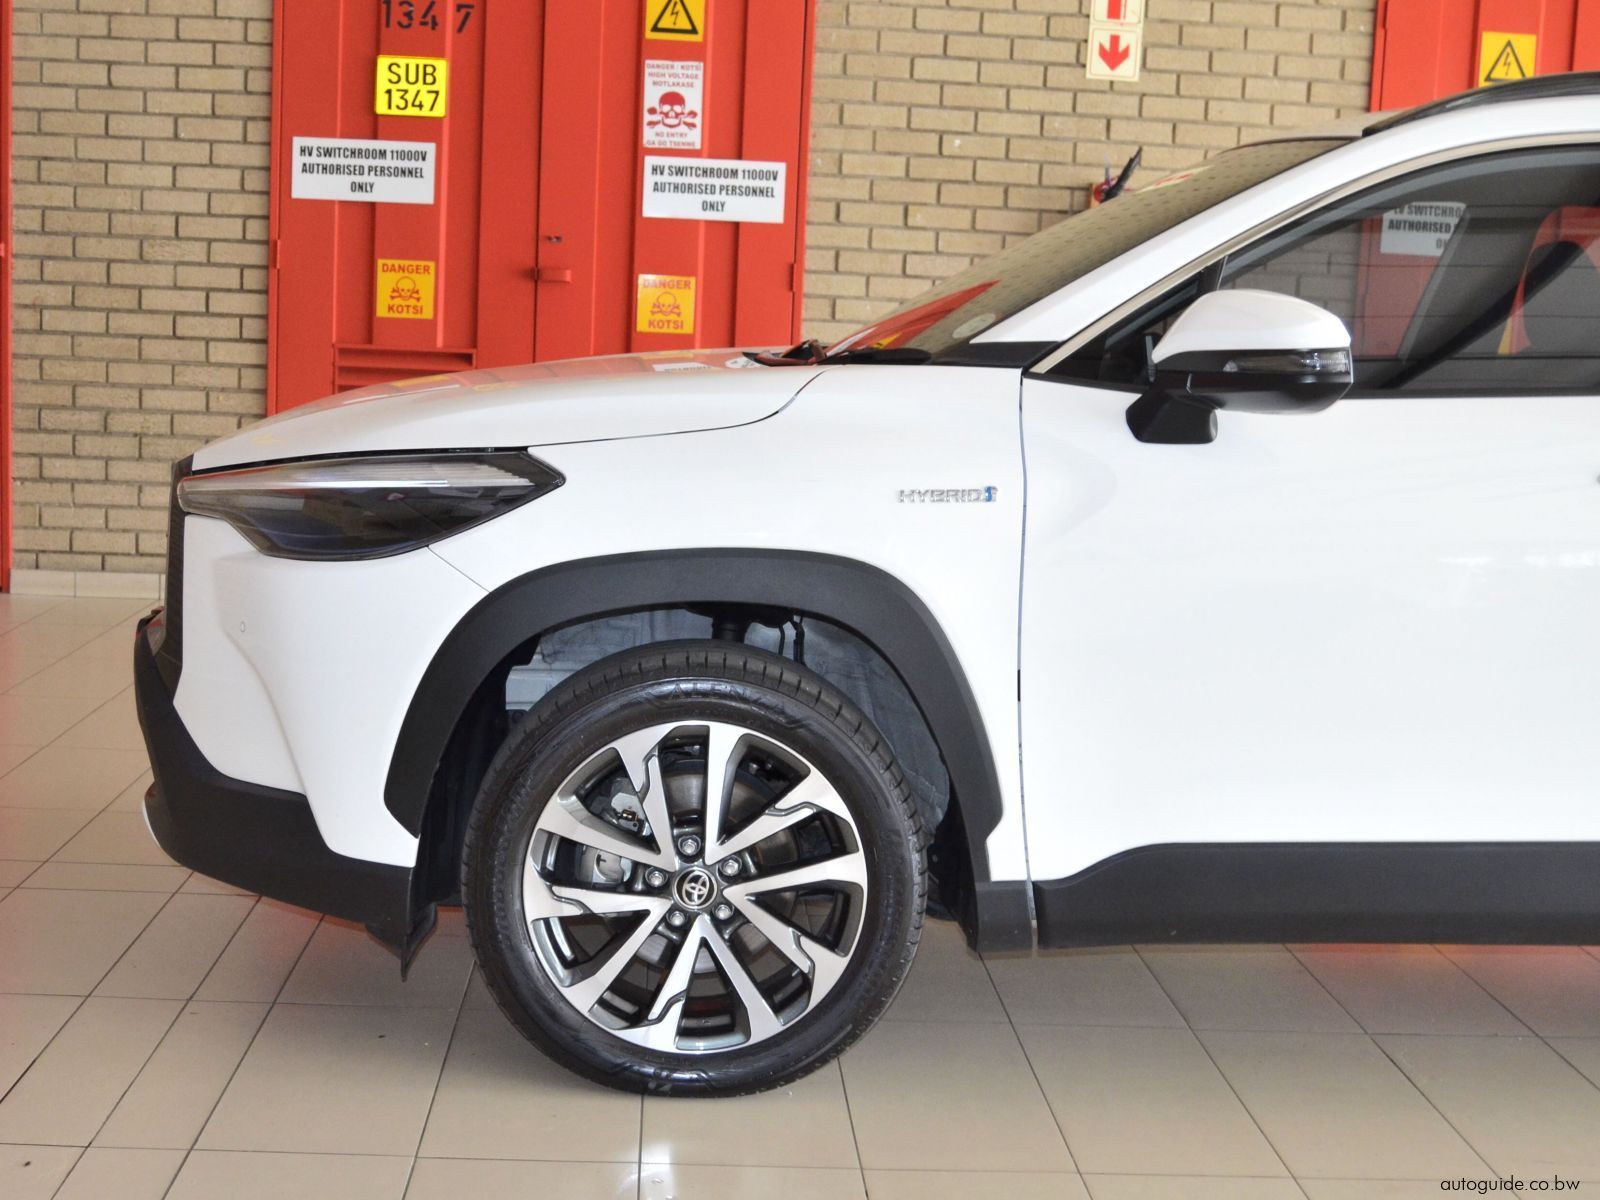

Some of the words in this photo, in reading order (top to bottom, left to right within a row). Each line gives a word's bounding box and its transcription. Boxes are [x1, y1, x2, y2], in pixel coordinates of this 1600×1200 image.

[646, 63, 675, 71] DANGER
[387, 62, 437, 86] SUB
[648, 71, 666, 79] HIGH
[668, 72, 699, 80] VOLTAGE
[384, 88, 440, 112] 1347
[299, 145, 314, 158] HV
[315, 146, 388, 160] SWITCHROOM
[390, 149, 428, 162] 11000V
[301, 162, 366, 176] AUTHORISED
[367, 165, 425, 178] PERSONNEL
[651, 164, 666, 176] HV
[667, 165, 739, 179] SWITCHROOM
[741, 168, 779, 181] 11000V
[350, 181, 375, 193] ONLY
[653, 181, 717, 195] AUTHORISED
[719, 184, 775, 198] PERSONNEL
[701, 200, 726, 212] ONLY
[1388, 219, 1451, 233] AUTHORISED
[381, 263, 431, 275] DANGER
[643, 279, 691, 290] DANGER
[387, 303, 423, 315] KOTSI
[648, 318, 684, 330] KOTSI
[898, 488, 982, 503] HYBRID
